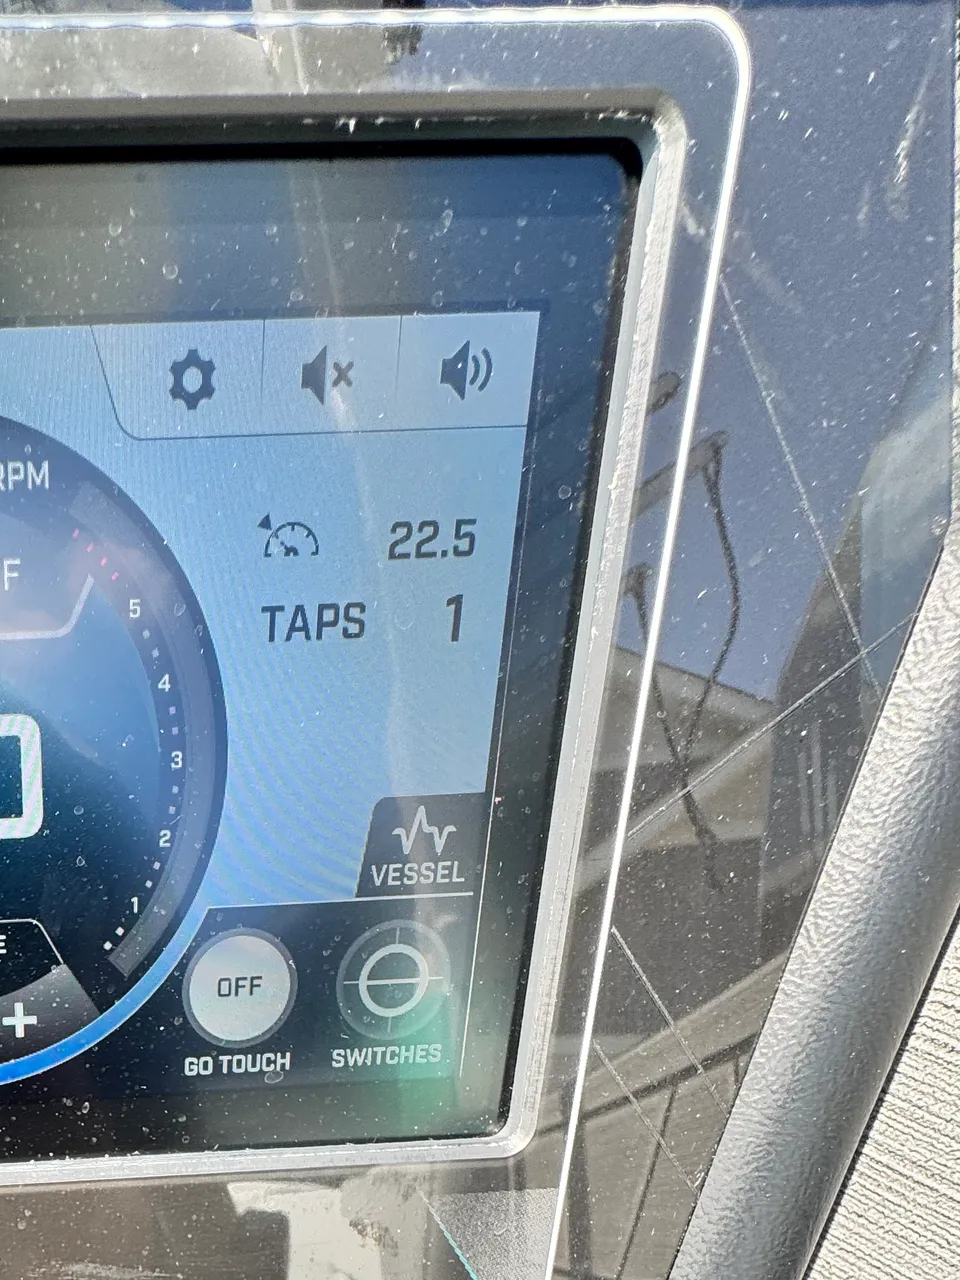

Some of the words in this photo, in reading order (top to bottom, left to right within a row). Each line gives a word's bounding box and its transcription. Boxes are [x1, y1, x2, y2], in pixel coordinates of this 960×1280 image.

[387, 518, 477, 560] 22.5
[128, 598, 141, 619] 5
[445, 593, 465, 643] 1
[260, 601, 367, 643] TAPS
[157, 673, 172, 693] 4
[169, 750, 184, 770] 3
[158, 828, 172, 849] 2
[370, 860, 466, 888] VESSEL
[130, 896, 140, 914] 1
[216, 974, 263, 999] OFF
[182, 1053, 215, 1078] GO
[218, 1050, 292, 1076] TOUCH
[330, 1043, 443, 1069] SWITCHES
